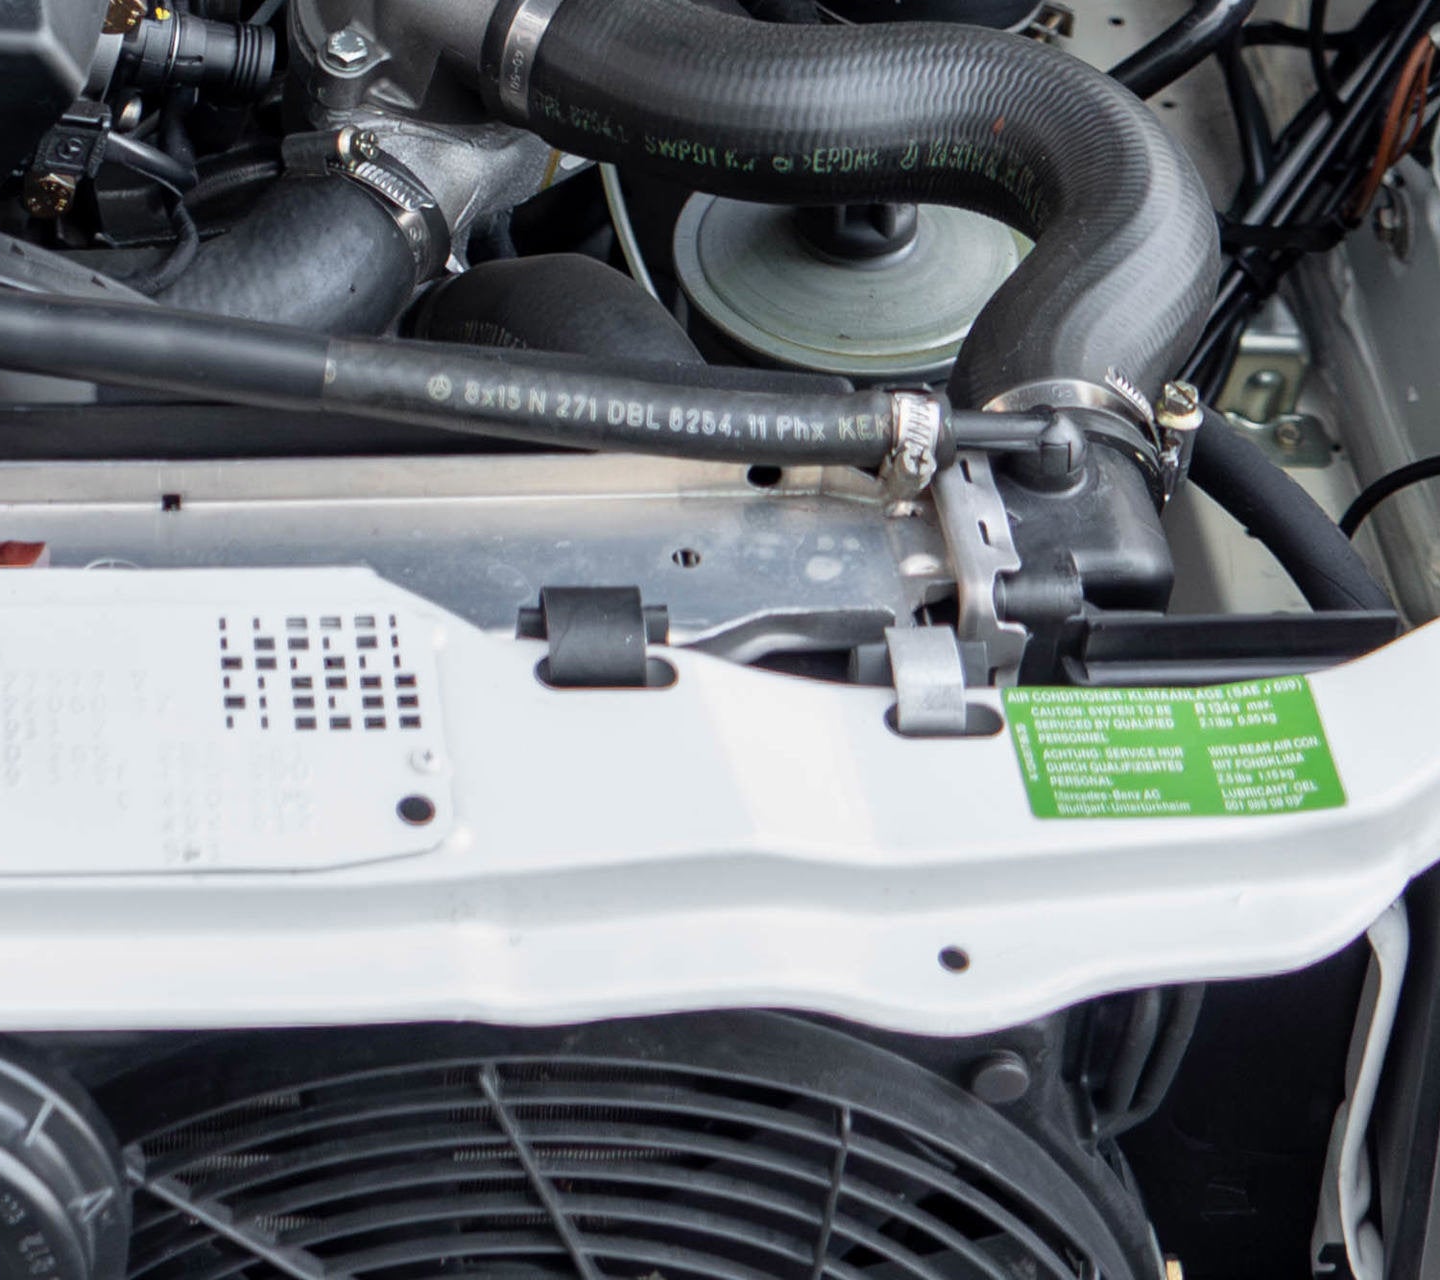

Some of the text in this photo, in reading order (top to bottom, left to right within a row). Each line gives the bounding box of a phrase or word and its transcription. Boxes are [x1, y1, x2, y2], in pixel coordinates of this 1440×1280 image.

[528, 387, 547, 415] N
[556, 392, 598, 422] 271
[608, 399, 661, 431] DBL
[777, 415, 825, 441] Phx
[1007, 691, 1030, 704] AIR
[1112, 718, 1175, 730] QUALIFIED
